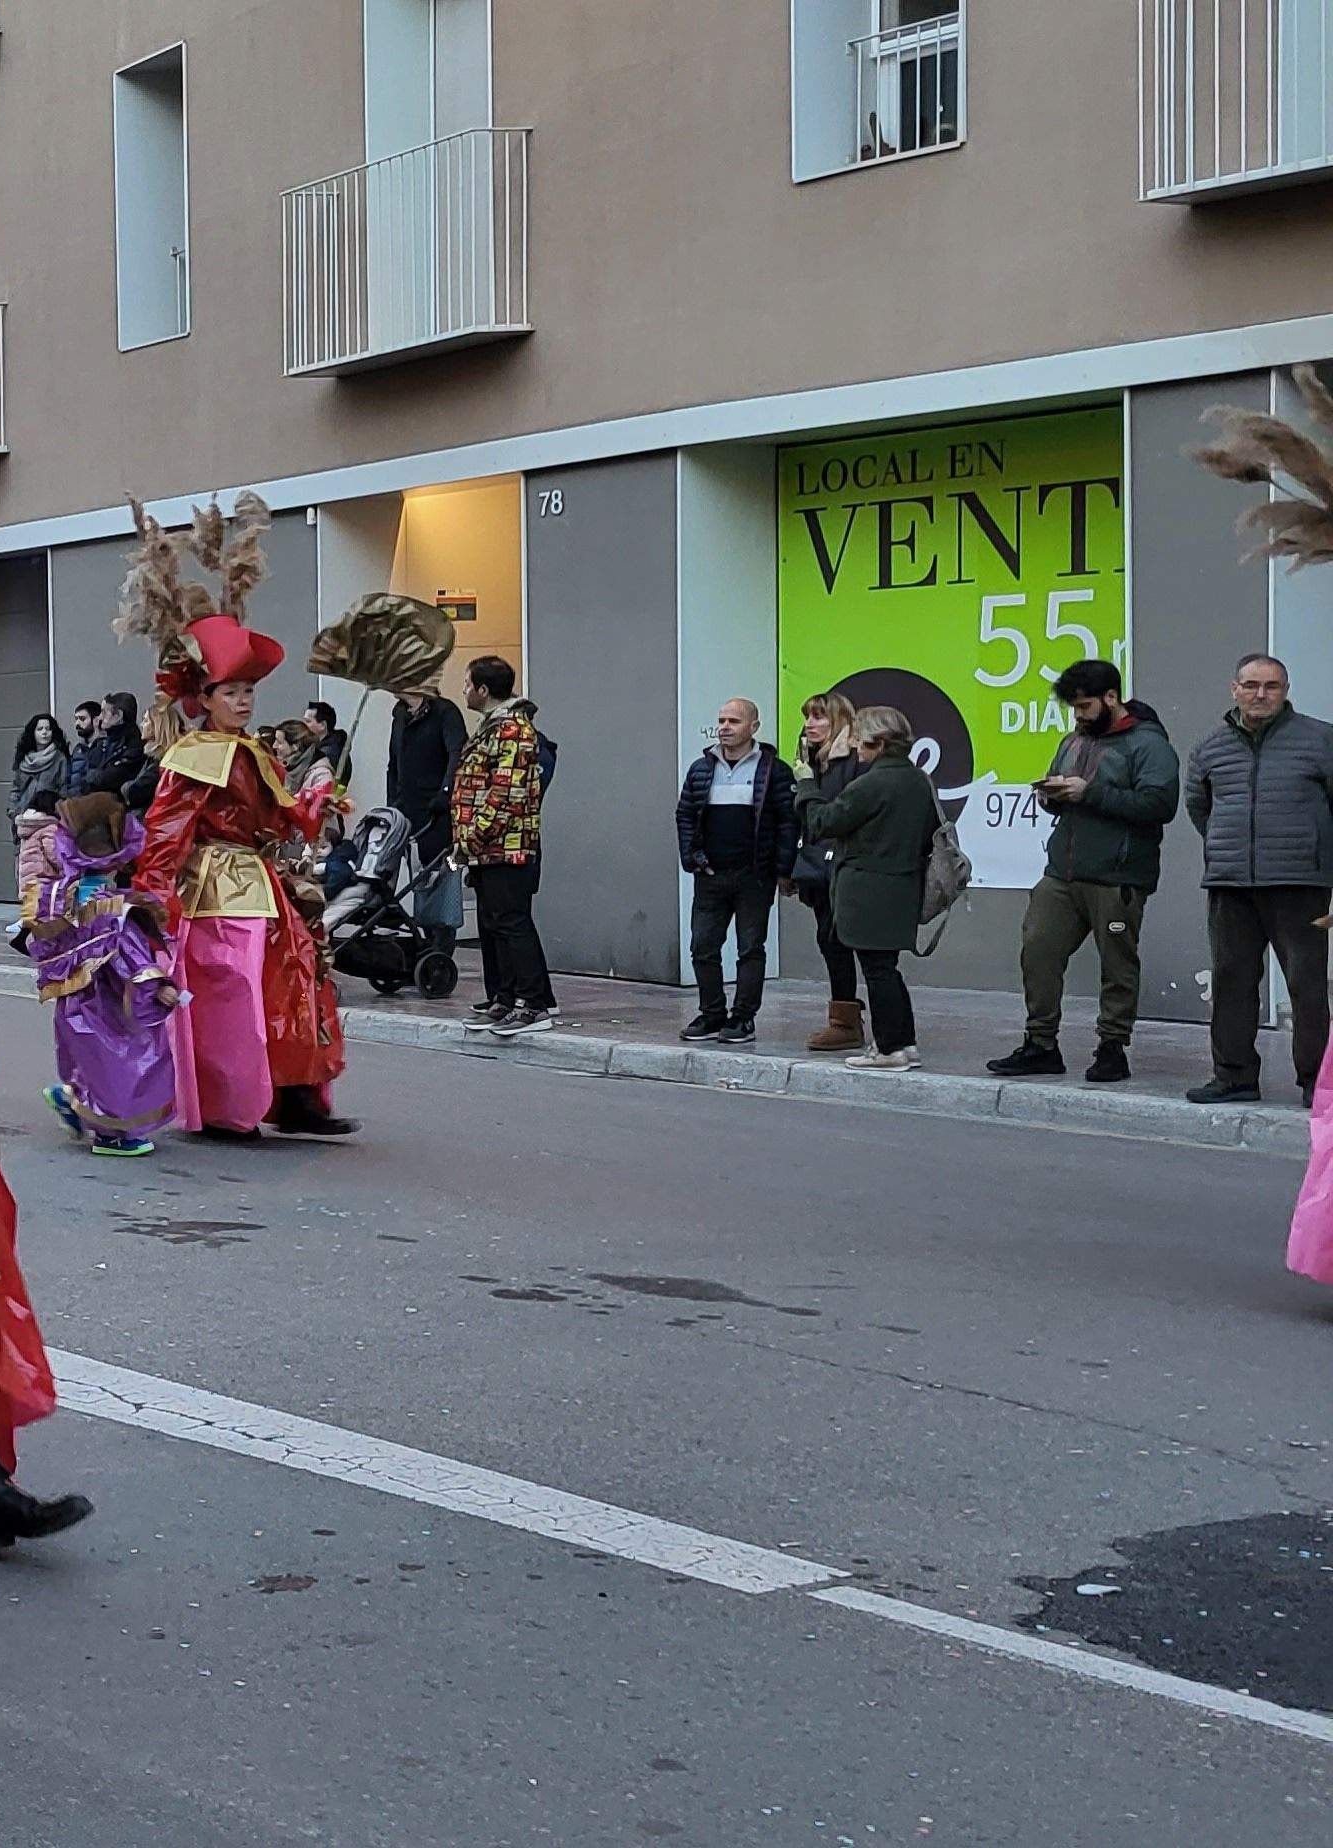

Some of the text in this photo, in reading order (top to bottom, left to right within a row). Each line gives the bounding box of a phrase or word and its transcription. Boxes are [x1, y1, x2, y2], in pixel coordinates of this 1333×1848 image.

[795, 439, 1006, 496] LOCAL EN
[538, 489, 563, 517] 78
[793, 477, 1125, 596] VENT
[985, 792, 1040, 828] 974
